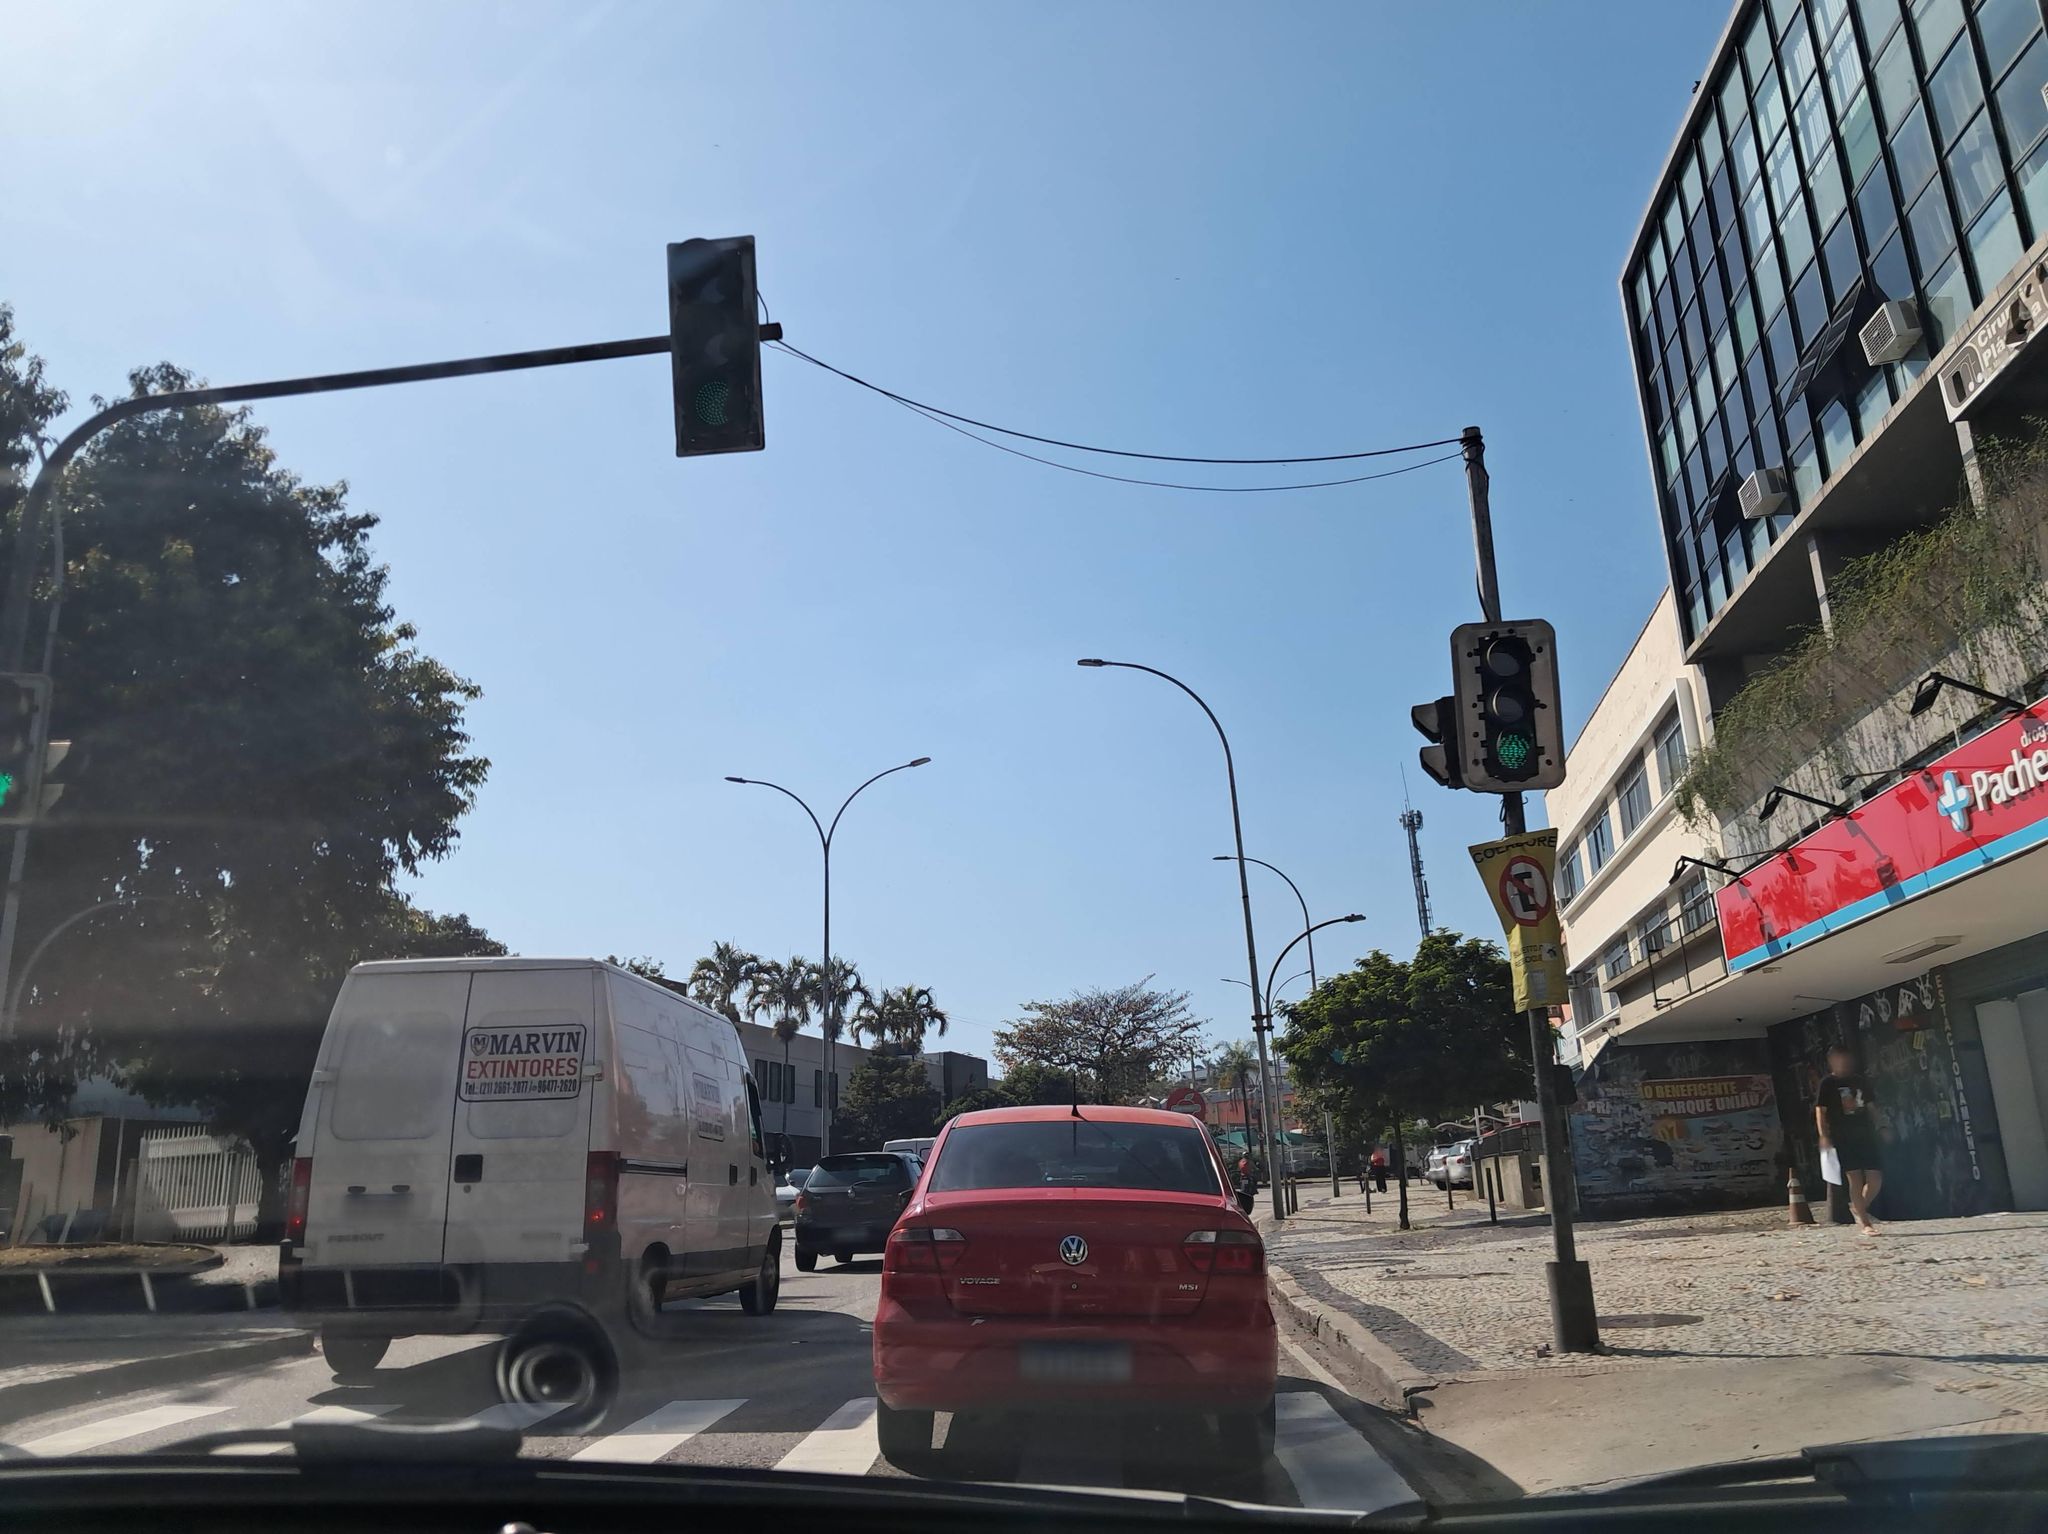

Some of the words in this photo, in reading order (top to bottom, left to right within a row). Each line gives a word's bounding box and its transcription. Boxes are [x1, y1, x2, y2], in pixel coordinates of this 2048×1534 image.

[2020, 721, 2048, 748] drog
[488, 1031, 581, 1055] MARVIN
[467, 1057, 578, 1079] EXTINTORES
[1656, 1081, 1737, 1099] BENEFICENTE
[1660, 1099, 1713, 1114] PARQUE
[959, 1276, 1001, 1285] VOYAGE
[1178, 1283, 1198, 1291] MSI
